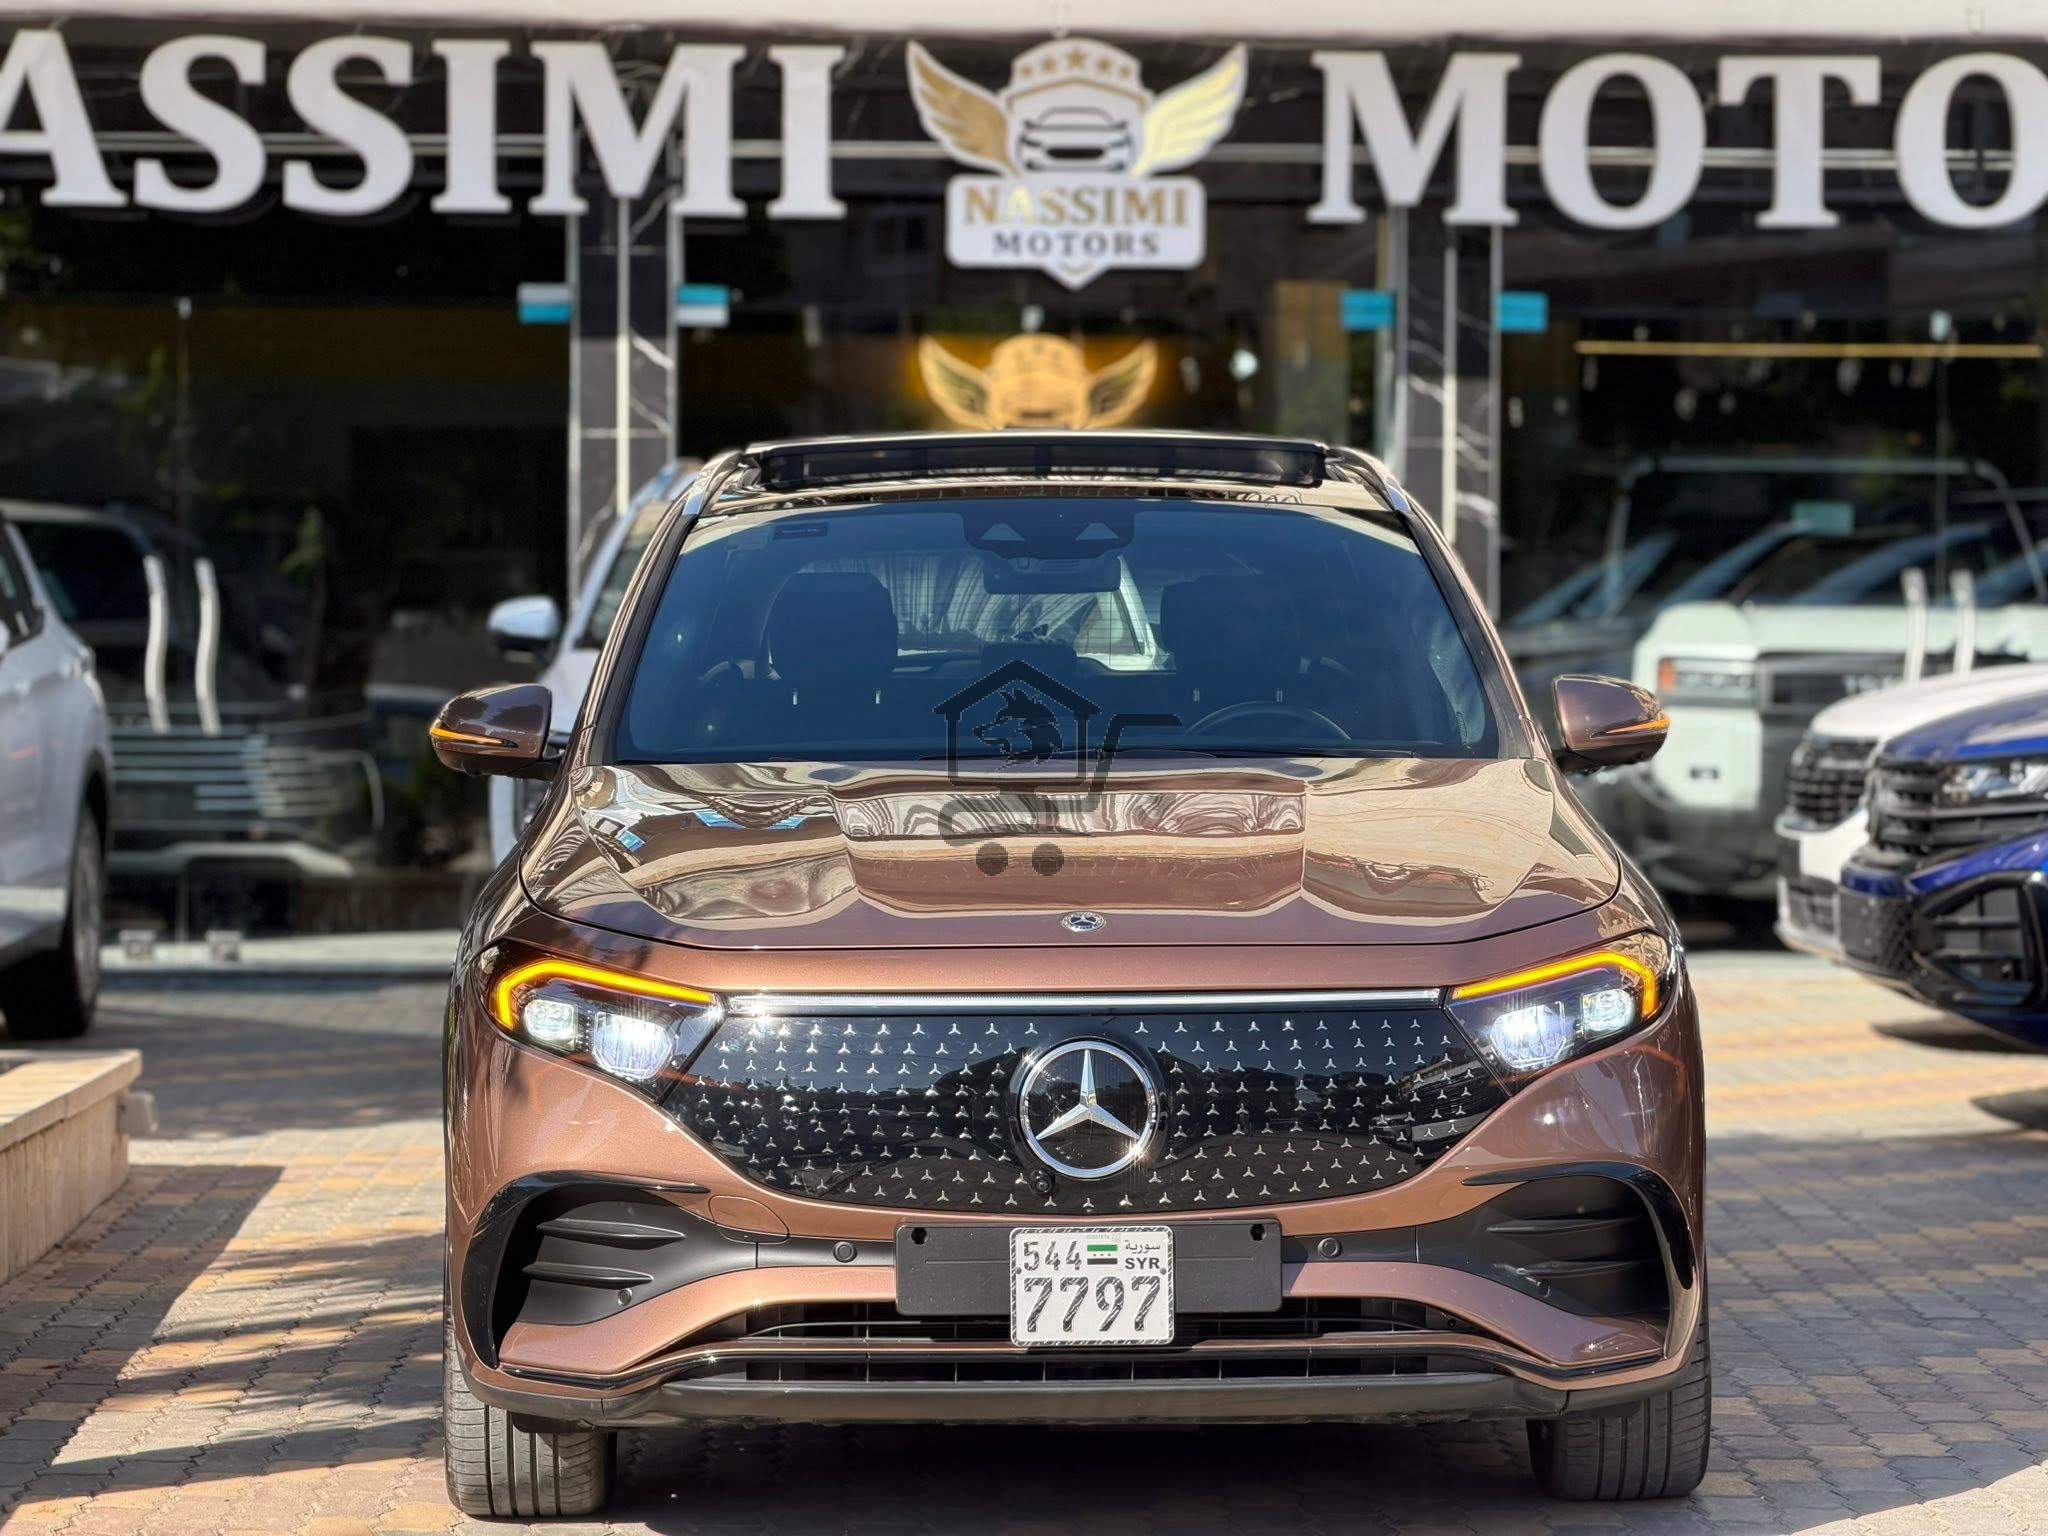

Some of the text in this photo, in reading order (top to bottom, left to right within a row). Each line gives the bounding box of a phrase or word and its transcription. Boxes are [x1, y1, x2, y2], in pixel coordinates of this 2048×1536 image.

[0, 29, 2048, 230] ASSIMI MOTO
[965, 186, 1189, 227] NASSIMI
[993, 232, 1159, 257] MOTORS
[1023, 1240, 1082, 1271] 544
[1124, 1239, 1161, 1254] سورية
[1124, 1257, 1161, 1270] SYR
[1023, 1275, 1161, 1333] 7797
